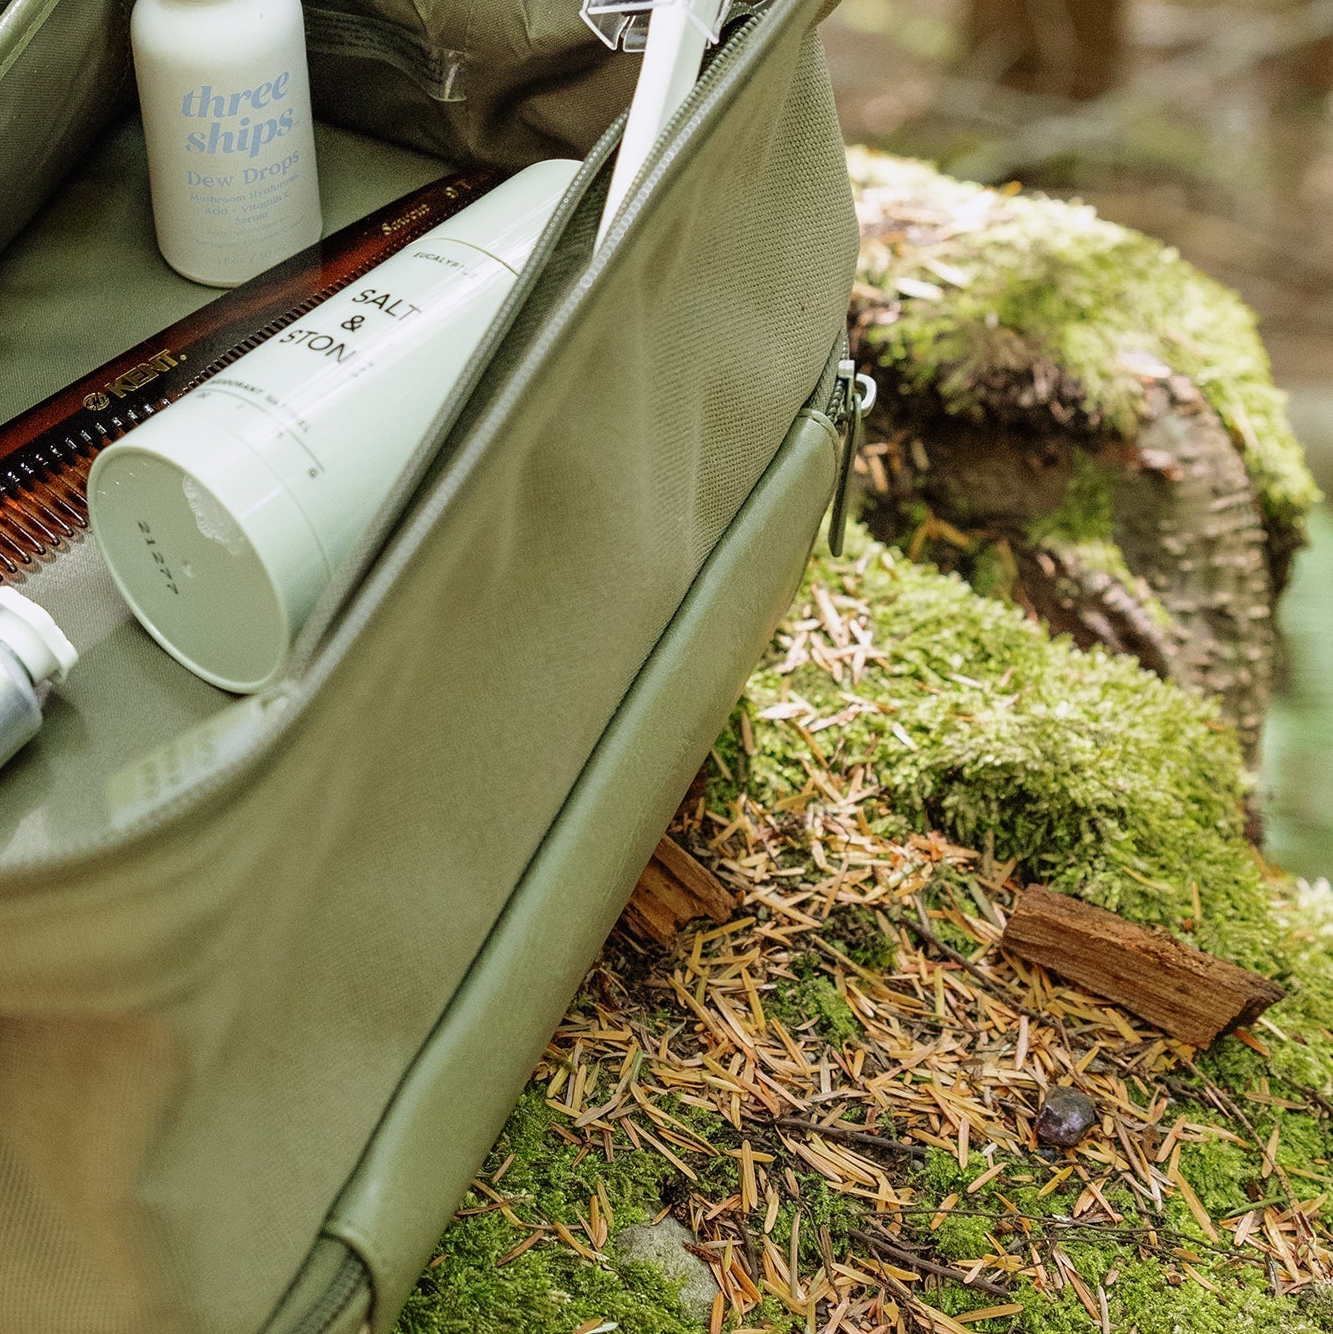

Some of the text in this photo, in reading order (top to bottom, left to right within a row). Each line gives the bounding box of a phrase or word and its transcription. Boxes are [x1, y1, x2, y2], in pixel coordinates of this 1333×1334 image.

[182, 71, 290, 118] three
[186, 108, 294, 158] ships
[186, 150, 300, 187] Dew Drops
[189, 193, 246, 204] Mushroom
[205, 207, 228, 215] Acid
[241, 195, 282, 213] Vitamin
[235, 212, 268, 225] Serum
[352, 288, 422, 321] SALT
[341, 314, 366, 333] &
[279, 328, 373, 378] STON
[104, 348, 179, 399] KENT
[137, 520, 179, 595] 21277
